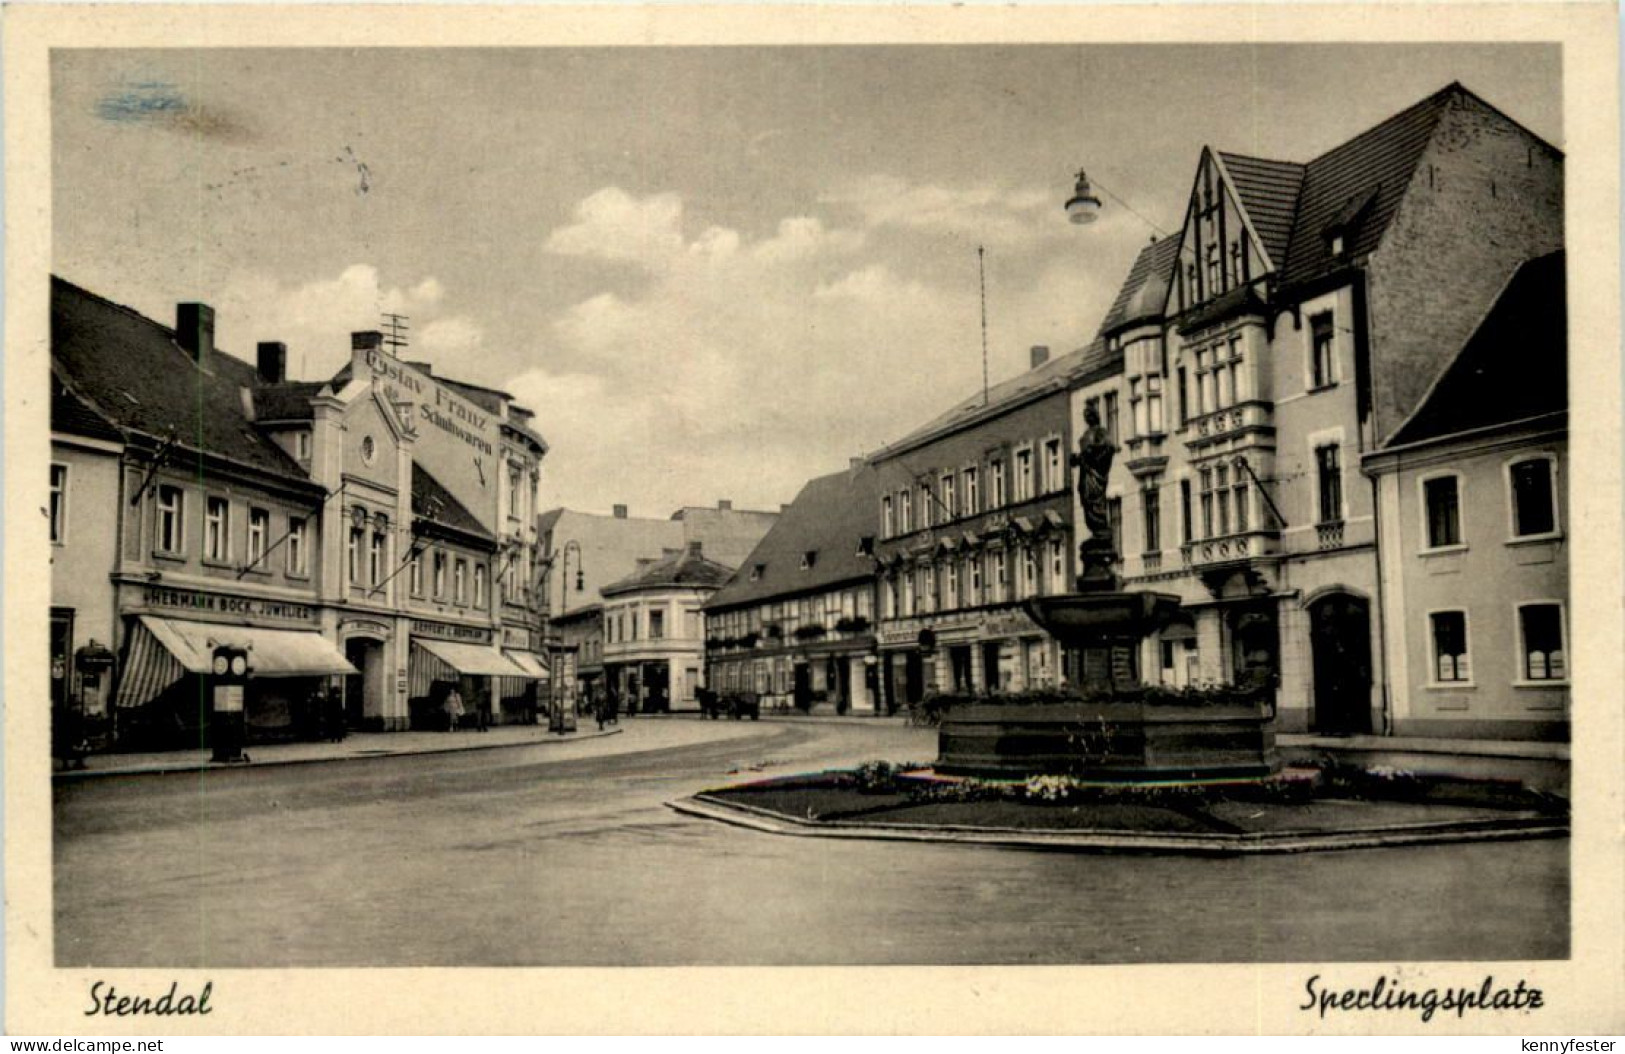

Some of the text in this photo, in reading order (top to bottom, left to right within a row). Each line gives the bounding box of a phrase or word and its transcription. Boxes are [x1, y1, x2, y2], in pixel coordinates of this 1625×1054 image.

[366, 349, 487, 431] Gustav Franz
[420, 403, 492, 456] Schuhwaren
[152, 591, 213, 609] HERMANN
[259, 603, 308, 618] JUWELIER
[85, 982, 212, 1016] Stendal
[1301, 976, 1543, 1022] Sperlingsplatz
